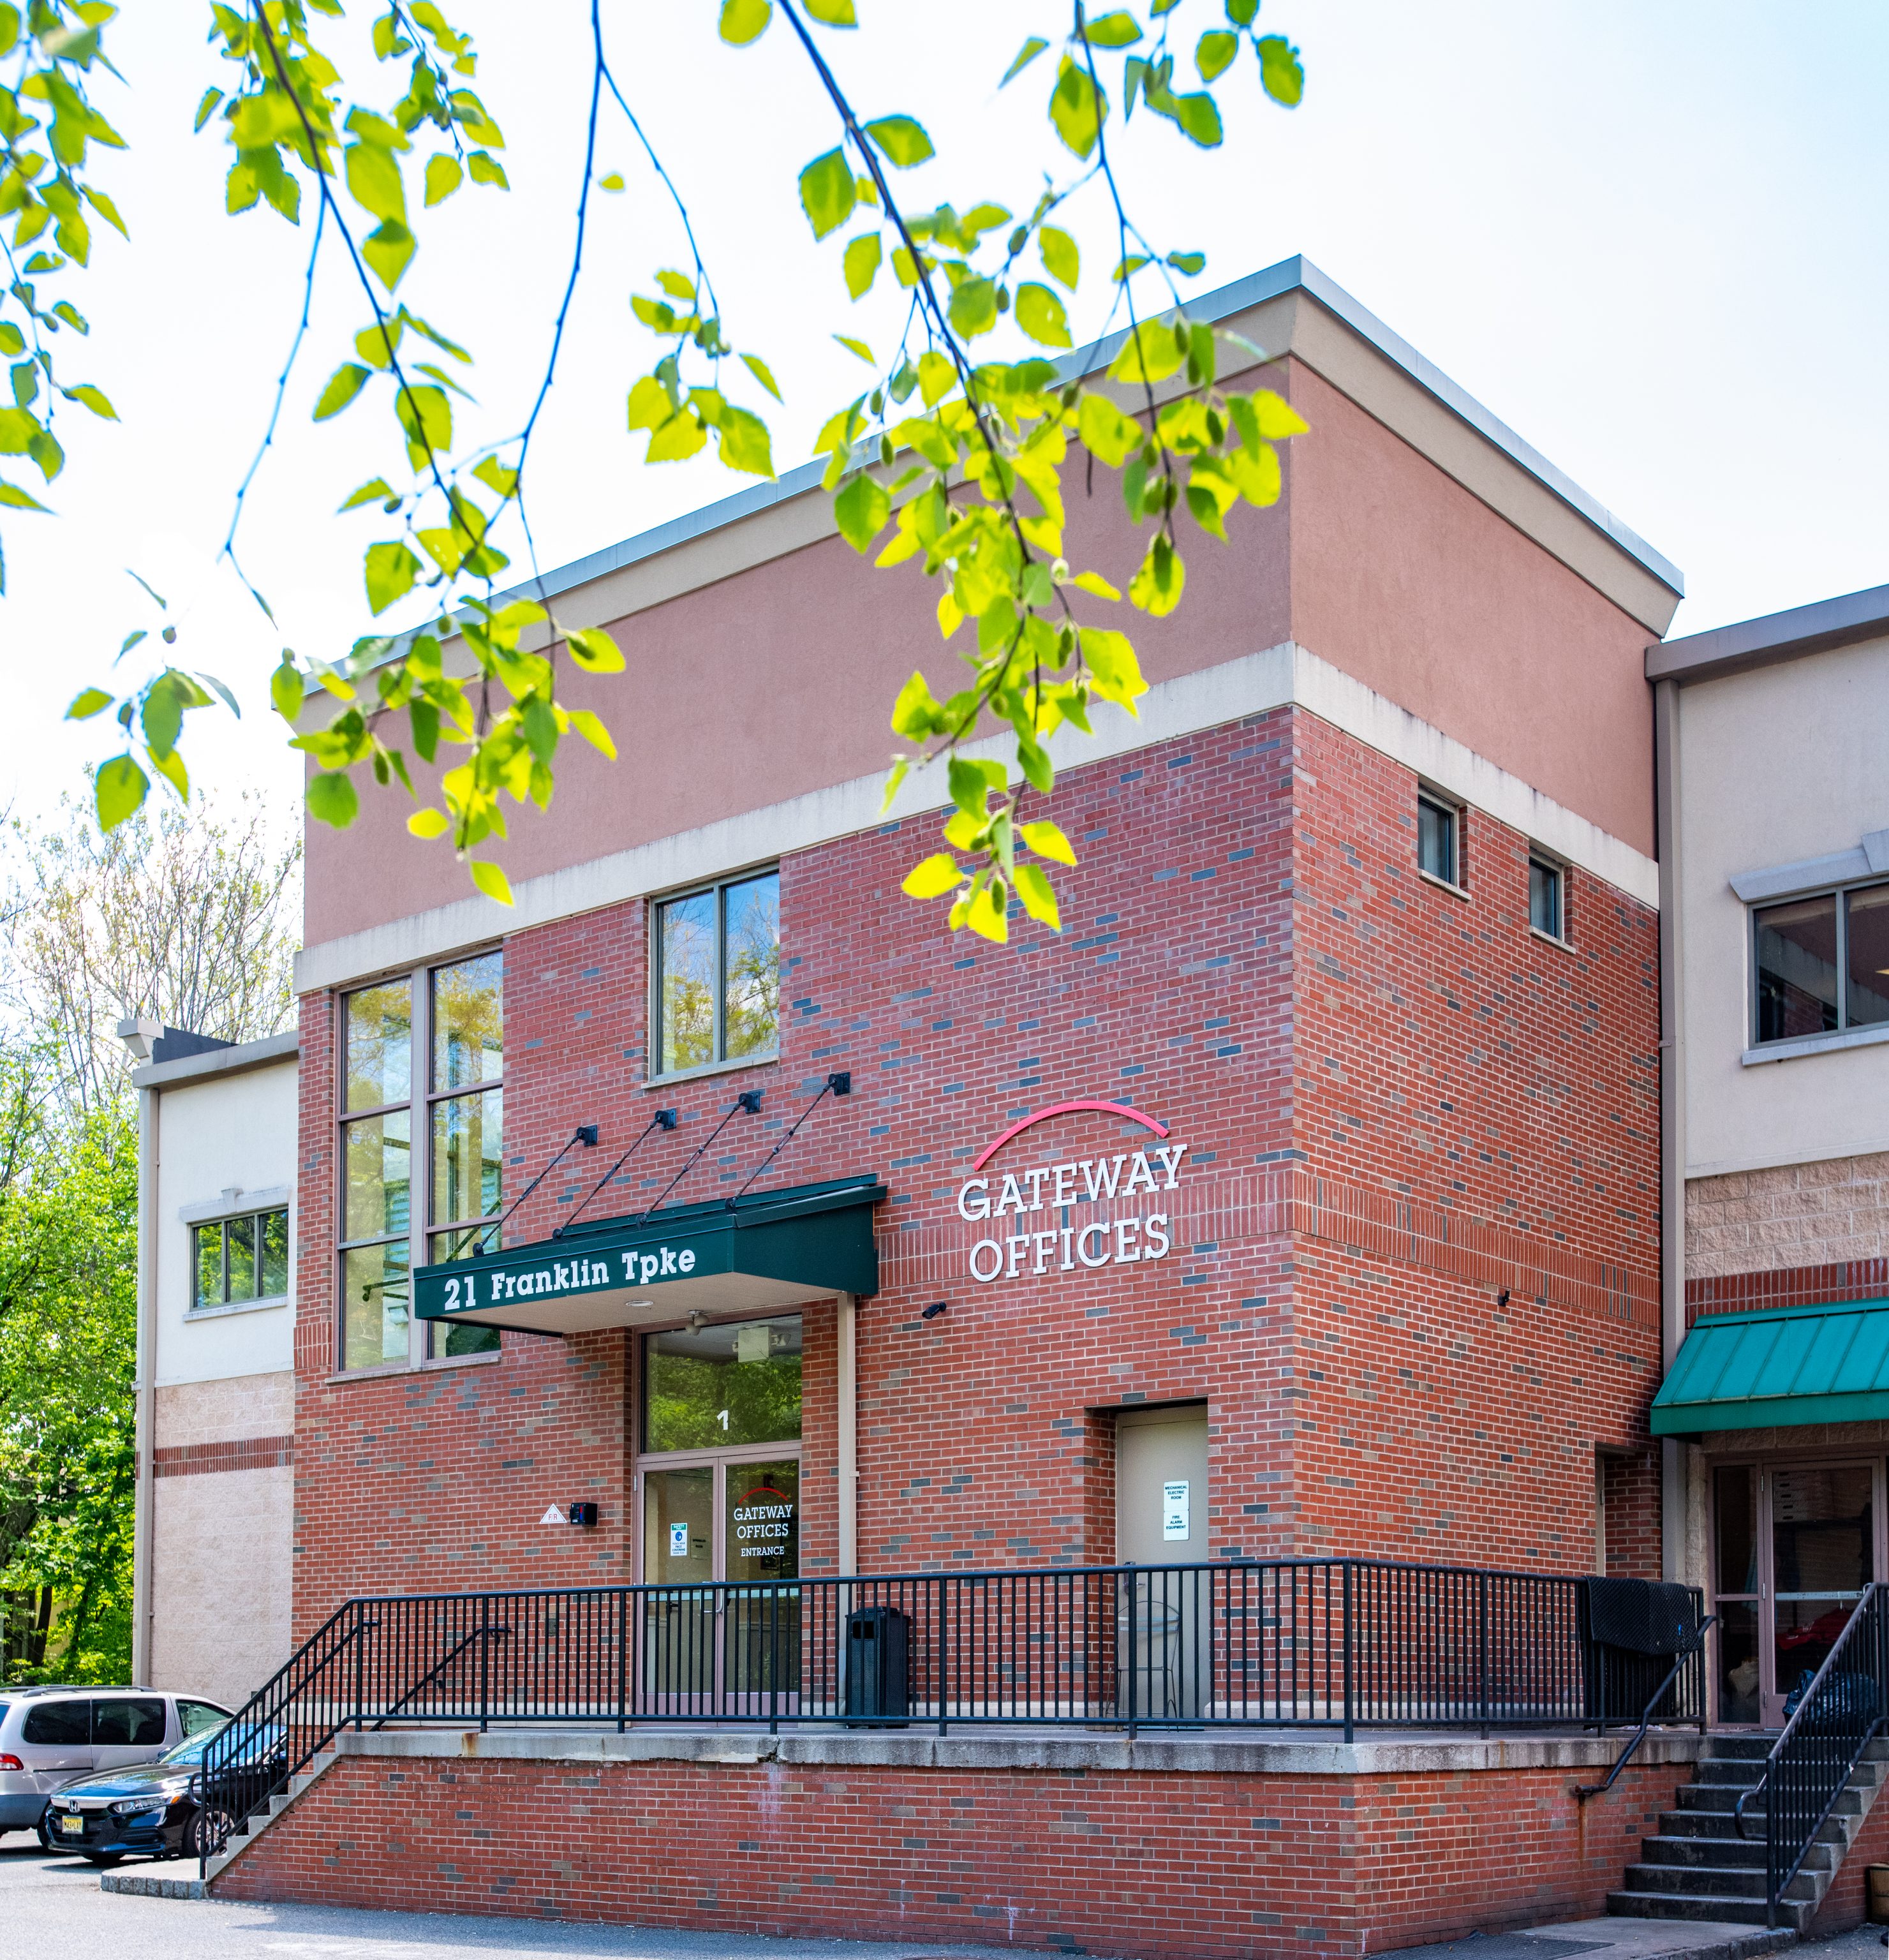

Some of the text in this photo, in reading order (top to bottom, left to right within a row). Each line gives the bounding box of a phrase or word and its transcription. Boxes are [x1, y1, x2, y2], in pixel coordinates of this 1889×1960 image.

[958, 1143, 1188, 1221] GATEWAY
[969, 1214, 1170, 1282] OFFICES
[445, 1247, 696, 1311] 21 Franklin Tpke
[716, 1409, 729, 1430] 1
[734, 1504, 793, 1521] GATEWAY
[737, 1523, 789, 1539] OFFICES
[741, 1546, 785, 1557] ENTRANCE
